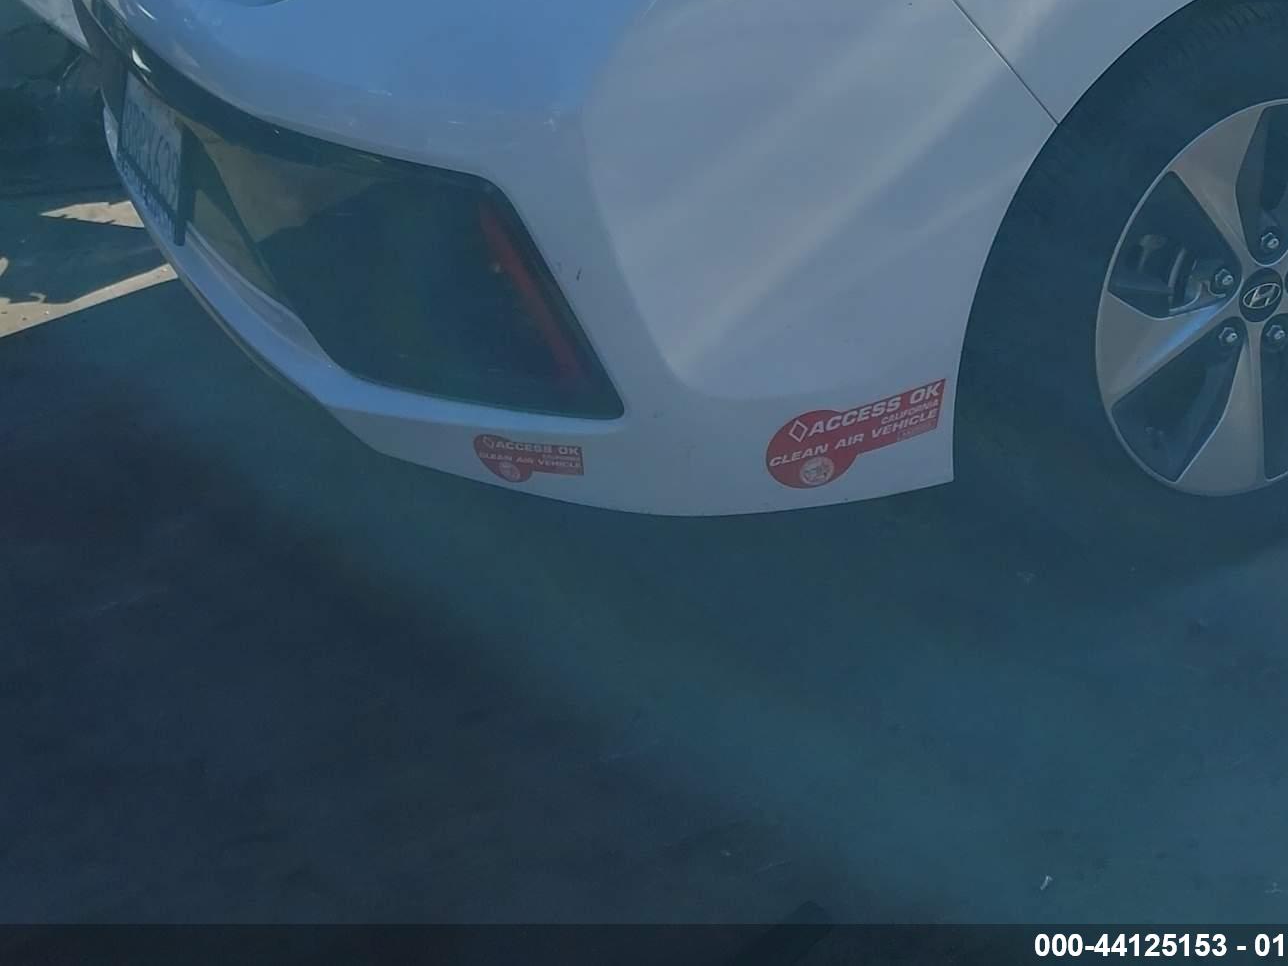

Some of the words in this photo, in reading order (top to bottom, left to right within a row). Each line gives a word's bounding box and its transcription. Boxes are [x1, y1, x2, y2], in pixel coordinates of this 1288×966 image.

[808, 397, 901, 437] ACCESS
[909, 381, 942, 405] OK
[881, 400, 939, 425] CALIFORNIA
[495, 441, 553, 454] ACCESS
[558, 446, 579, 455] OK
[769, 443, 829, 467] CLEAN
[835, 433, 865, 449] AIR
[872, 409, 938, 438] VEHICLE
